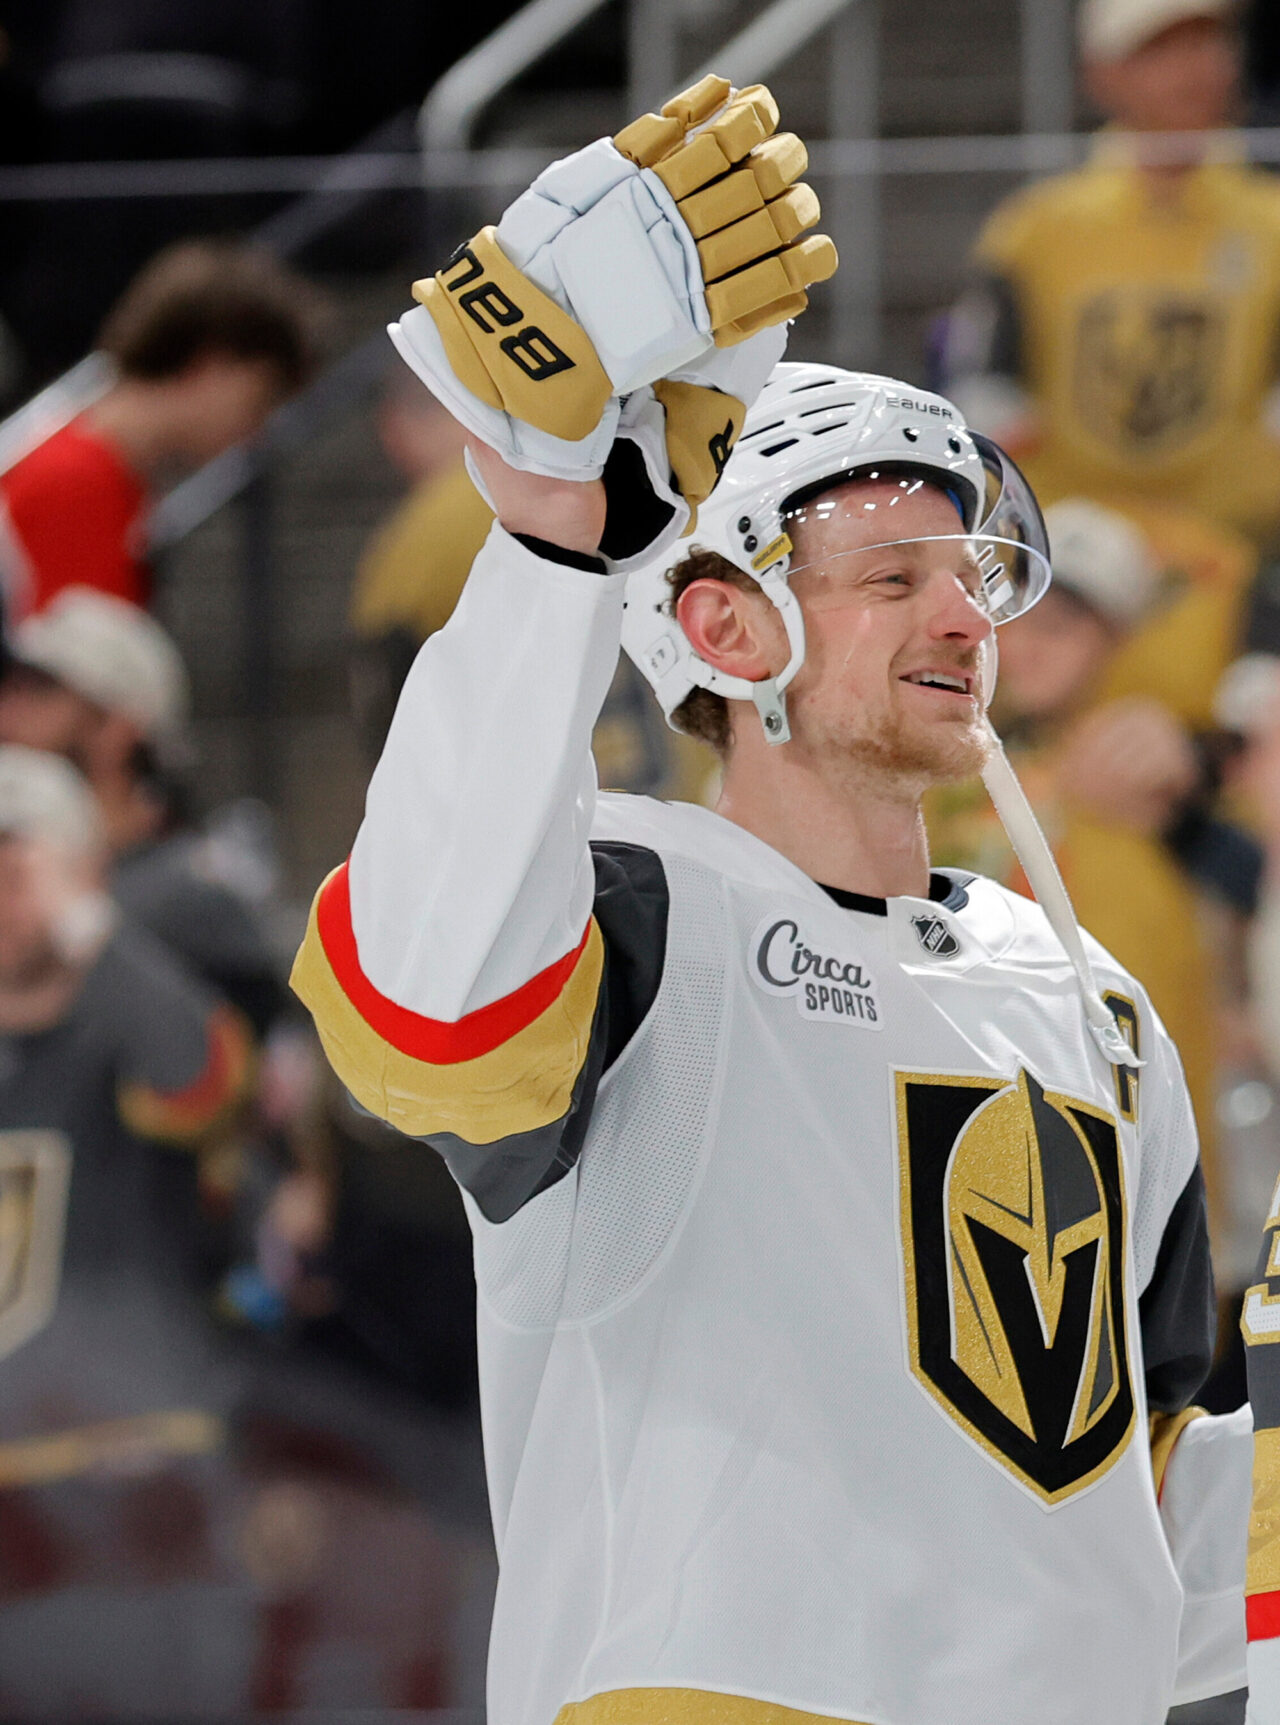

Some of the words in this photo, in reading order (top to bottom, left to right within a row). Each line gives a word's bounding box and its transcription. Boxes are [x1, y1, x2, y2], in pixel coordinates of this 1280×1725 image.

[756, 919, 871, 989] Circa
[926, 924, 945, 951] NHL
[805, 983, 878, 1023] SPORTS
